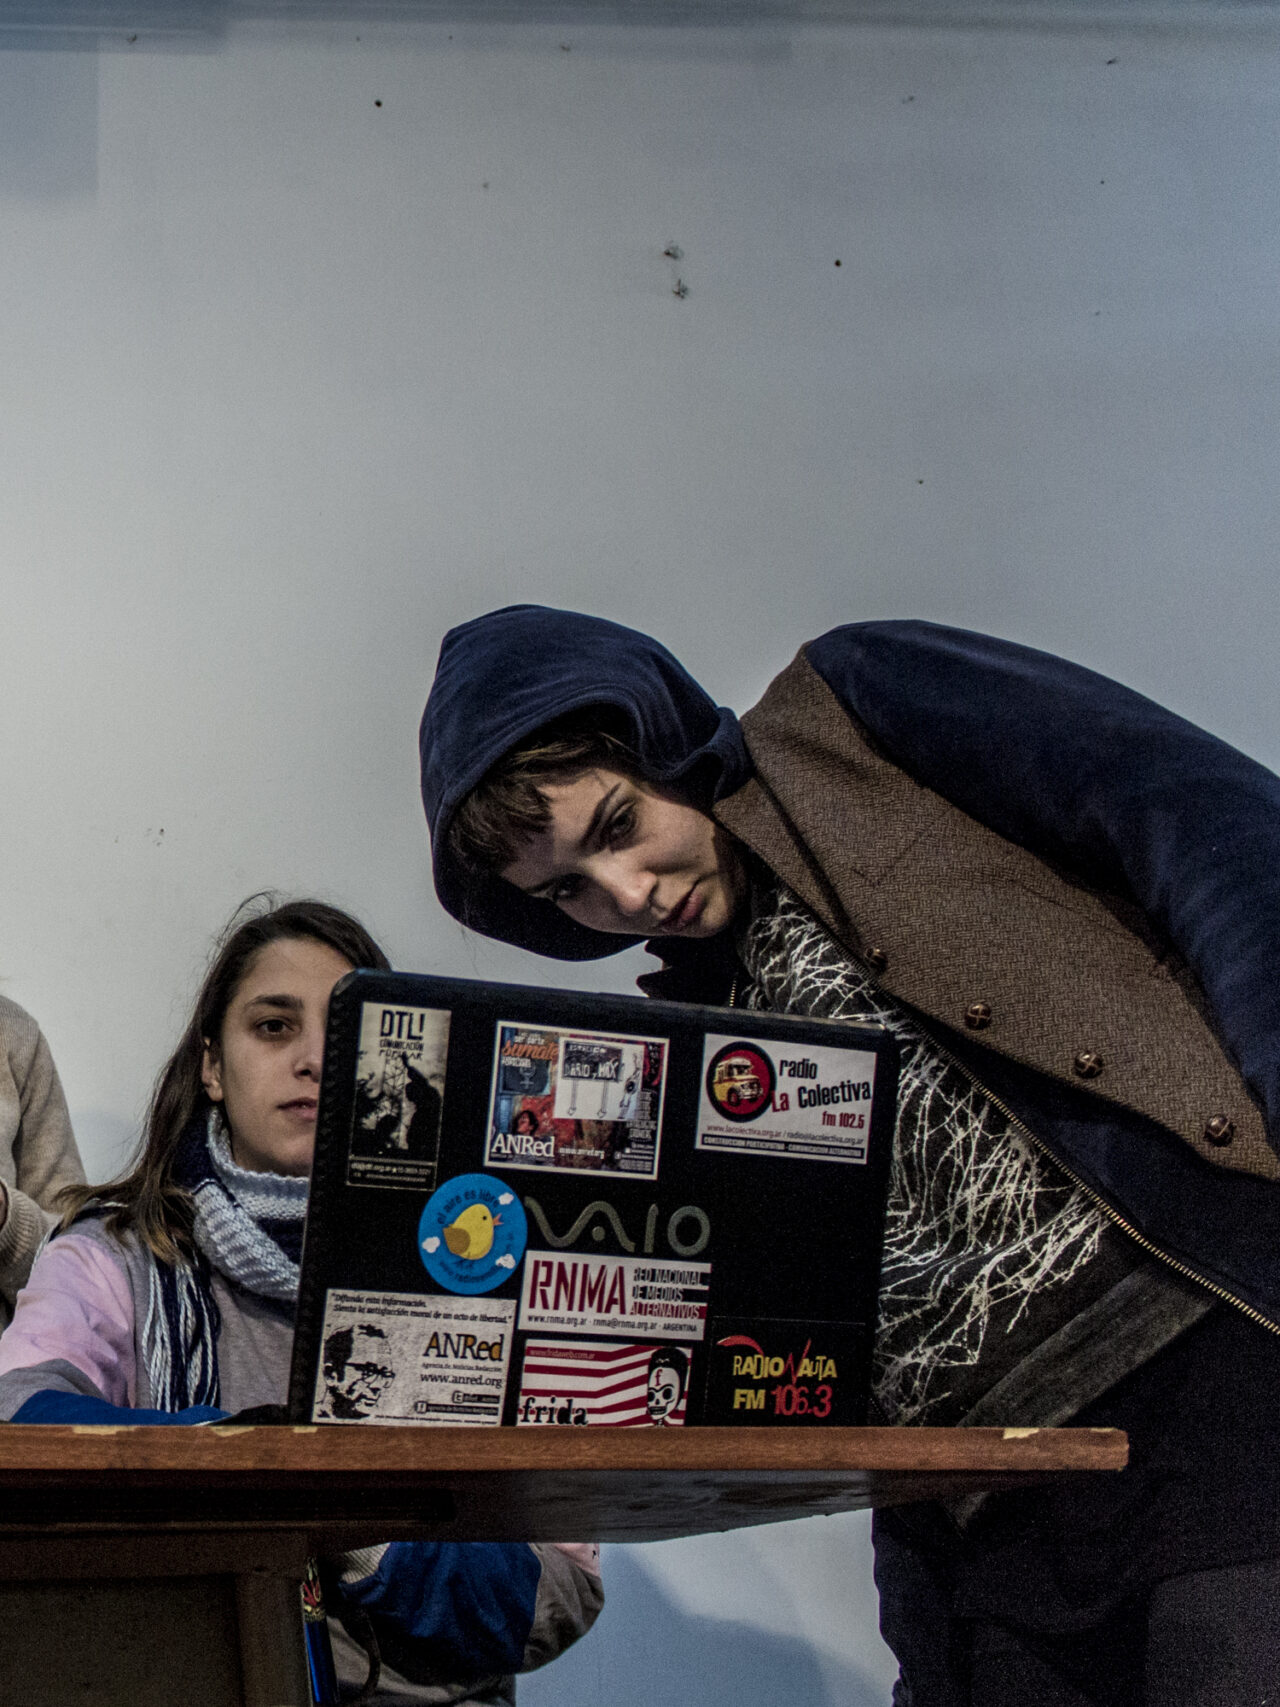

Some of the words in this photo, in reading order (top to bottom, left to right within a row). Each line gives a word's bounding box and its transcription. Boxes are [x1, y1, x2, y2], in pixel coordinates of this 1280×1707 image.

[380, 1009, 425, 1040] DTL!
[502, 1040, 559, 1060] sumate
[780, 1058, 818, 1079] radio
[771, 1090, 790, 1113] La
[798, 1079, 871, 1108] Colectiva
[822, 1111, 836, 1126] fm
[839, 1112, 865, 1129] 102.5
[707, 1125, 781, 1138] www.lacolectiva.org.ar
[491, 1132, 555, 1157] ANRed
[444, 1195, 462, 1213] aire
[464, 1190, 477, 1199] es
[479, 1189, 500, 1207] libre
[524, 1195, 710, 1257] VAIO
[528, 1260, 626, 1315] RNMA
[633, 1267, 652, 1283] RED
[654, 1268, 704, 1286] NACIONAL
[632, 1285, 644, 1299] DE
[645, 1286, 684, 1302] MEDIOS
[629, 1302, 701, 1320] ALTERNATIVOS
[527, 1314, 587, 1328] www.rnma.org.ar
[593, 1317, 657, 1331] rnma@rnma.org.ar
[662, 1324, 698, 1333] ARGENTINA
[423, 1331, 505, 1361] ANRed
[420, 1374, 502, 1389] www.anred.org
[520, 1396, 589, 1426] frida
[733, 1389, 766, 1410] FM
[770, 1384, 833, 1418] 106.3
